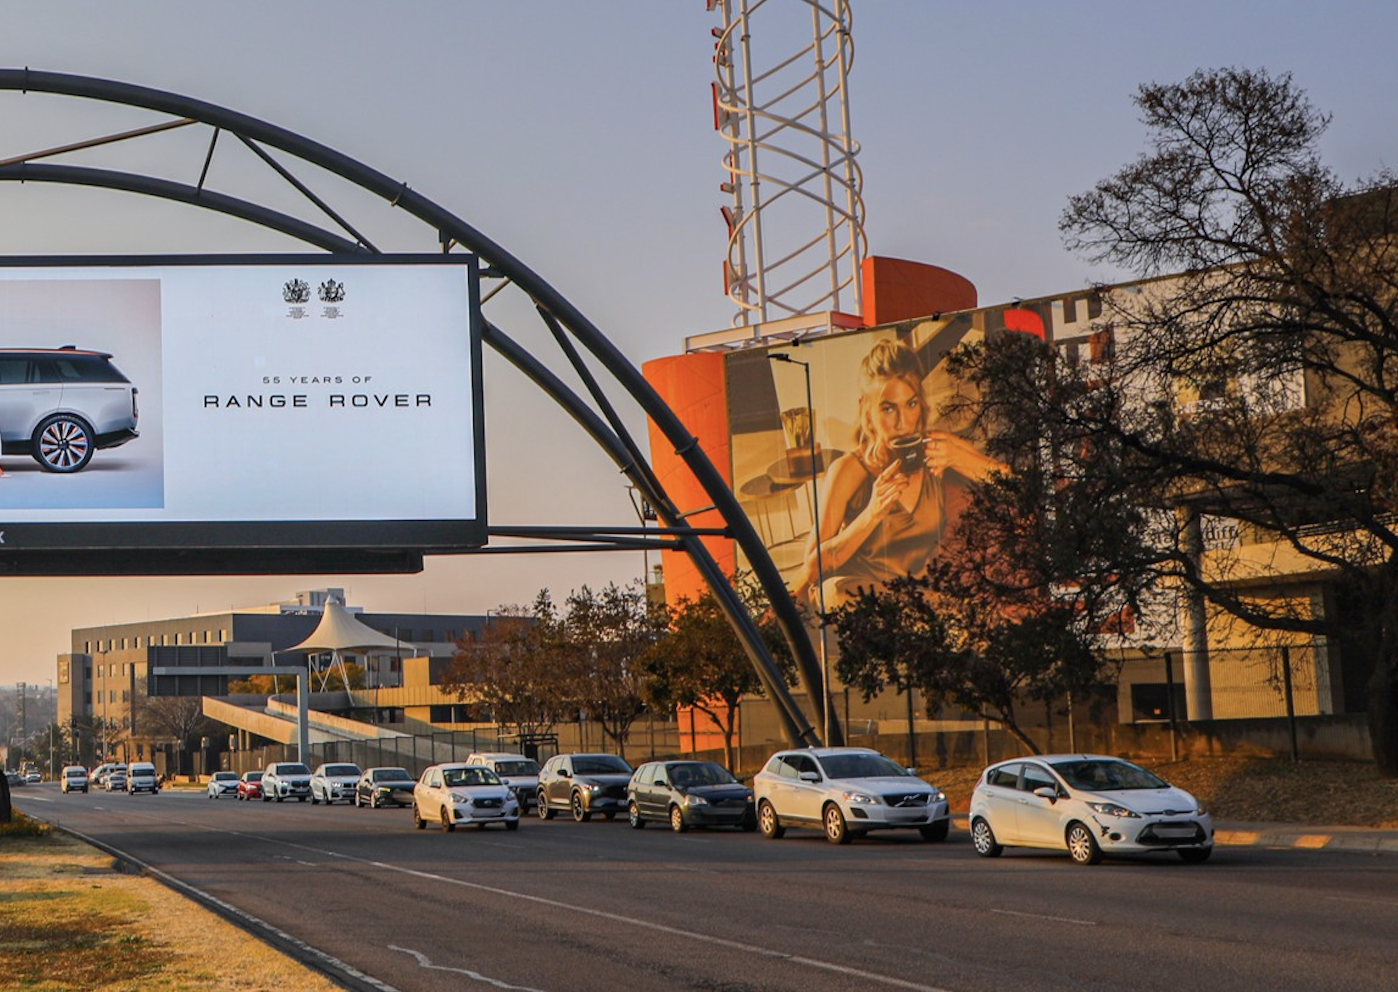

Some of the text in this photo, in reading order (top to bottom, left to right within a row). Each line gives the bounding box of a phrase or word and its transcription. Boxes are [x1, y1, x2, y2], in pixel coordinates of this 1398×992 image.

[262, 375, 372, 385] 55 YEARS OF
[203, 393, 432, 408] RANGE ROVER
